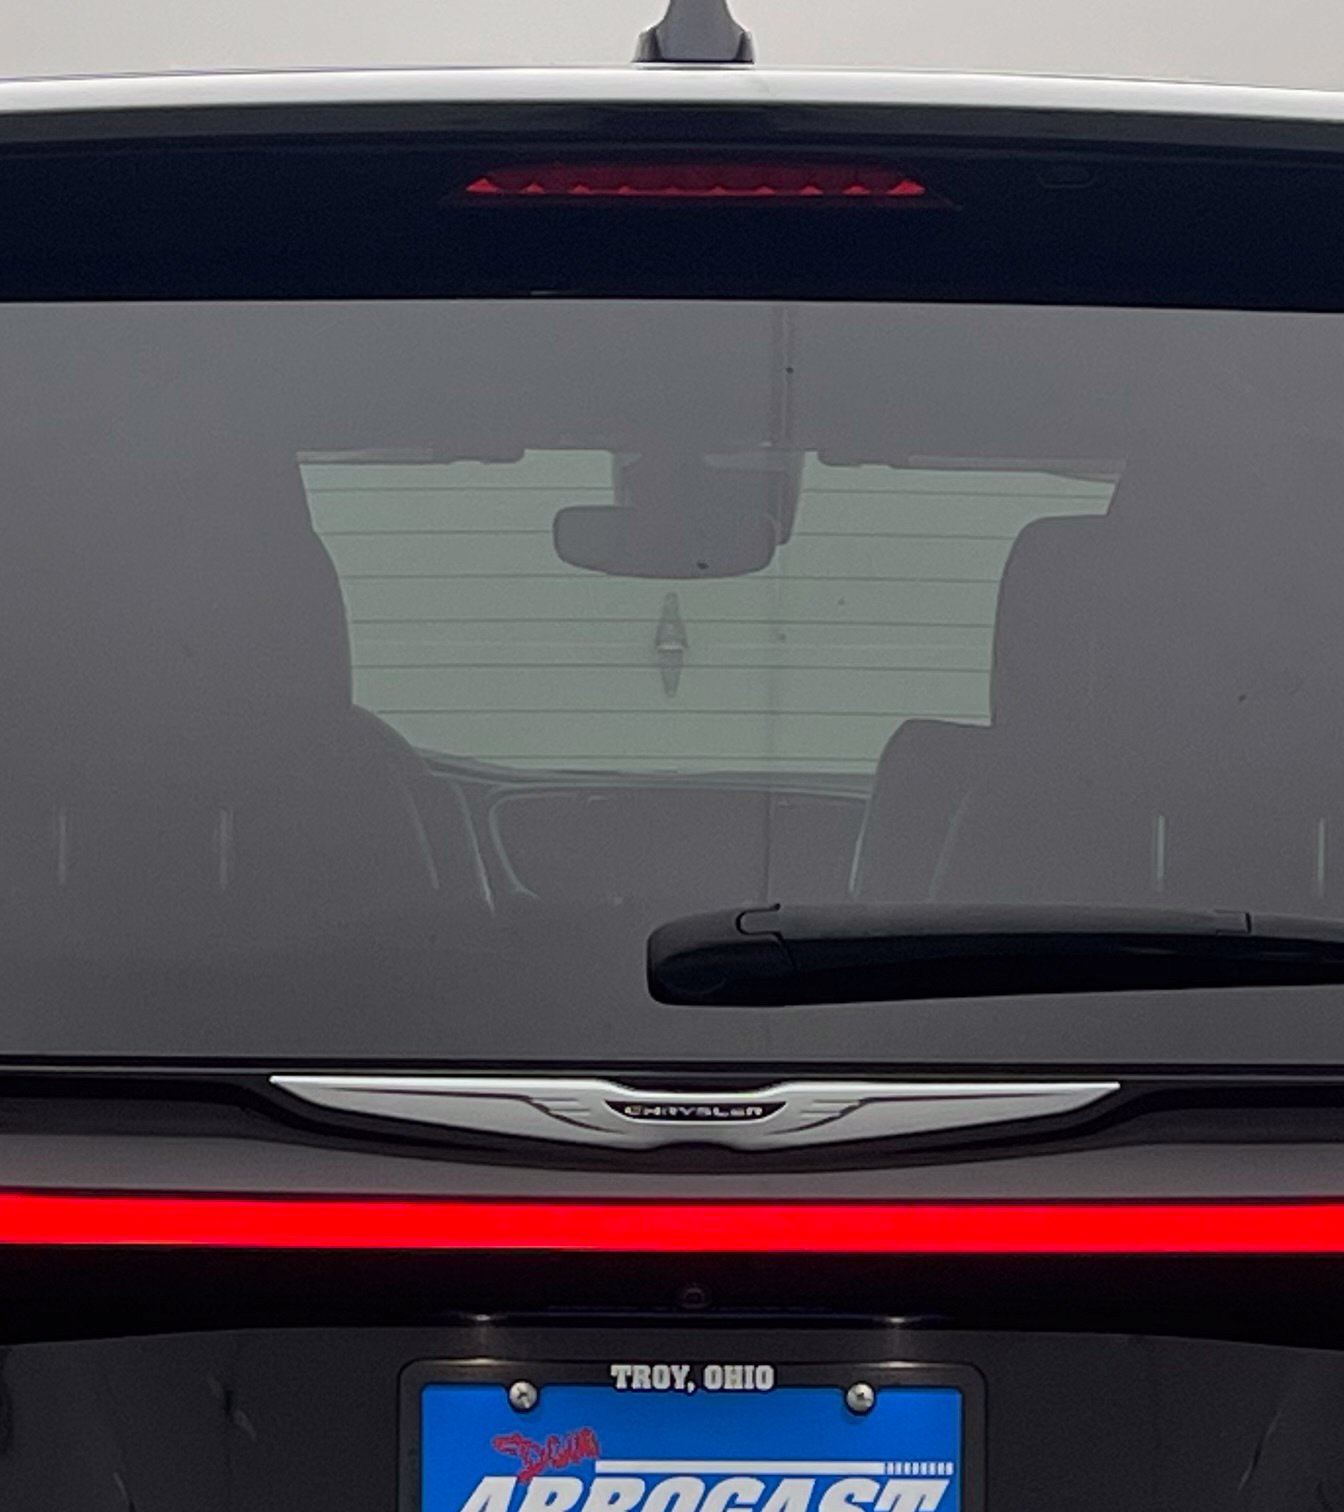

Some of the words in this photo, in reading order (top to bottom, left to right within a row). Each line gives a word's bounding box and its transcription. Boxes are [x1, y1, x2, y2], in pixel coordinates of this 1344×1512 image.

[623, 1105, 764, 1117] CHRYSLER
[610, 1364, 695, 1393] TROY,
[703, 1364, 775, 1390] OHIO
